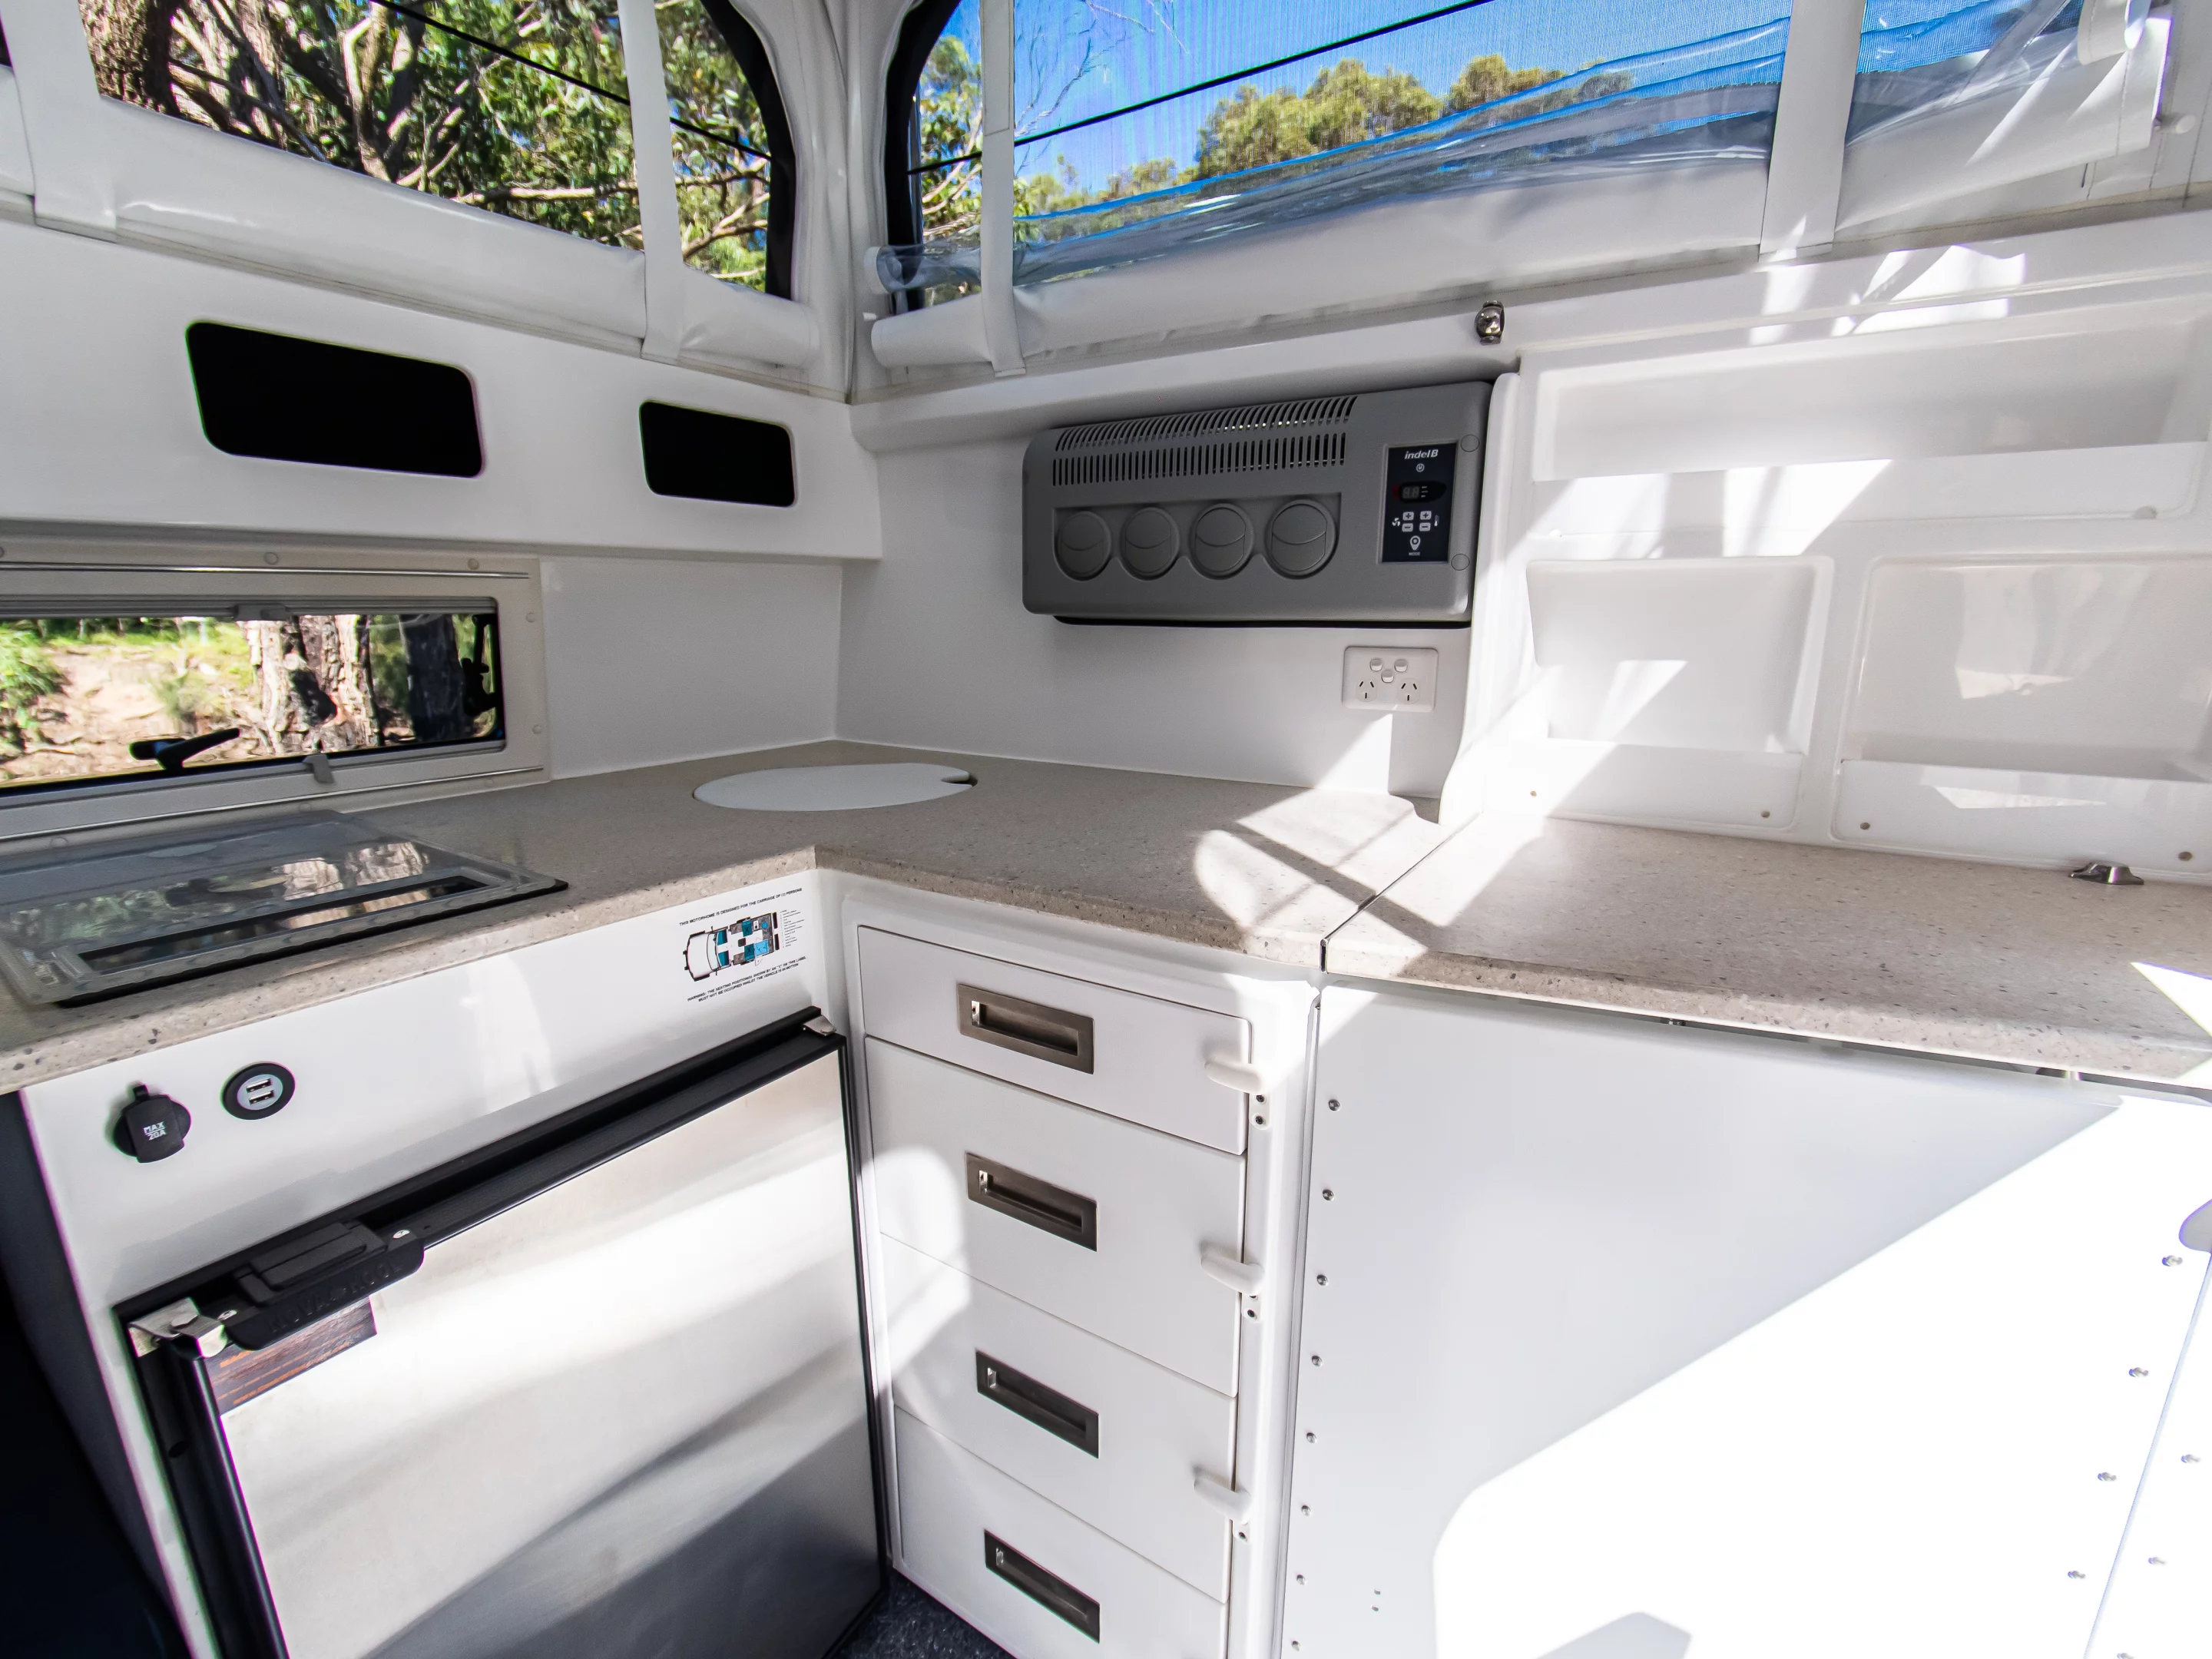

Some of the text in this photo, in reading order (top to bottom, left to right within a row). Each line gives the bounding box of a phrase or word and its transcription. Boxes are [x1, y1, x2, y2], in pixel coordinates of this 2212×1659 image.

[690, 912, 715, 923] MOTORHOME
[720, 906, 740, 915] DESIGNED
[757, 895, 775, 904] CARRIAGE
[715, 983, 731, 992] SEATING
[753, 969, 766, 978] SHOWN
[724, 983, 743, 992] OCCUPIED
[143, 1121, 164, 1131] MAX
[146, 1129, 167, 1141] 20A
